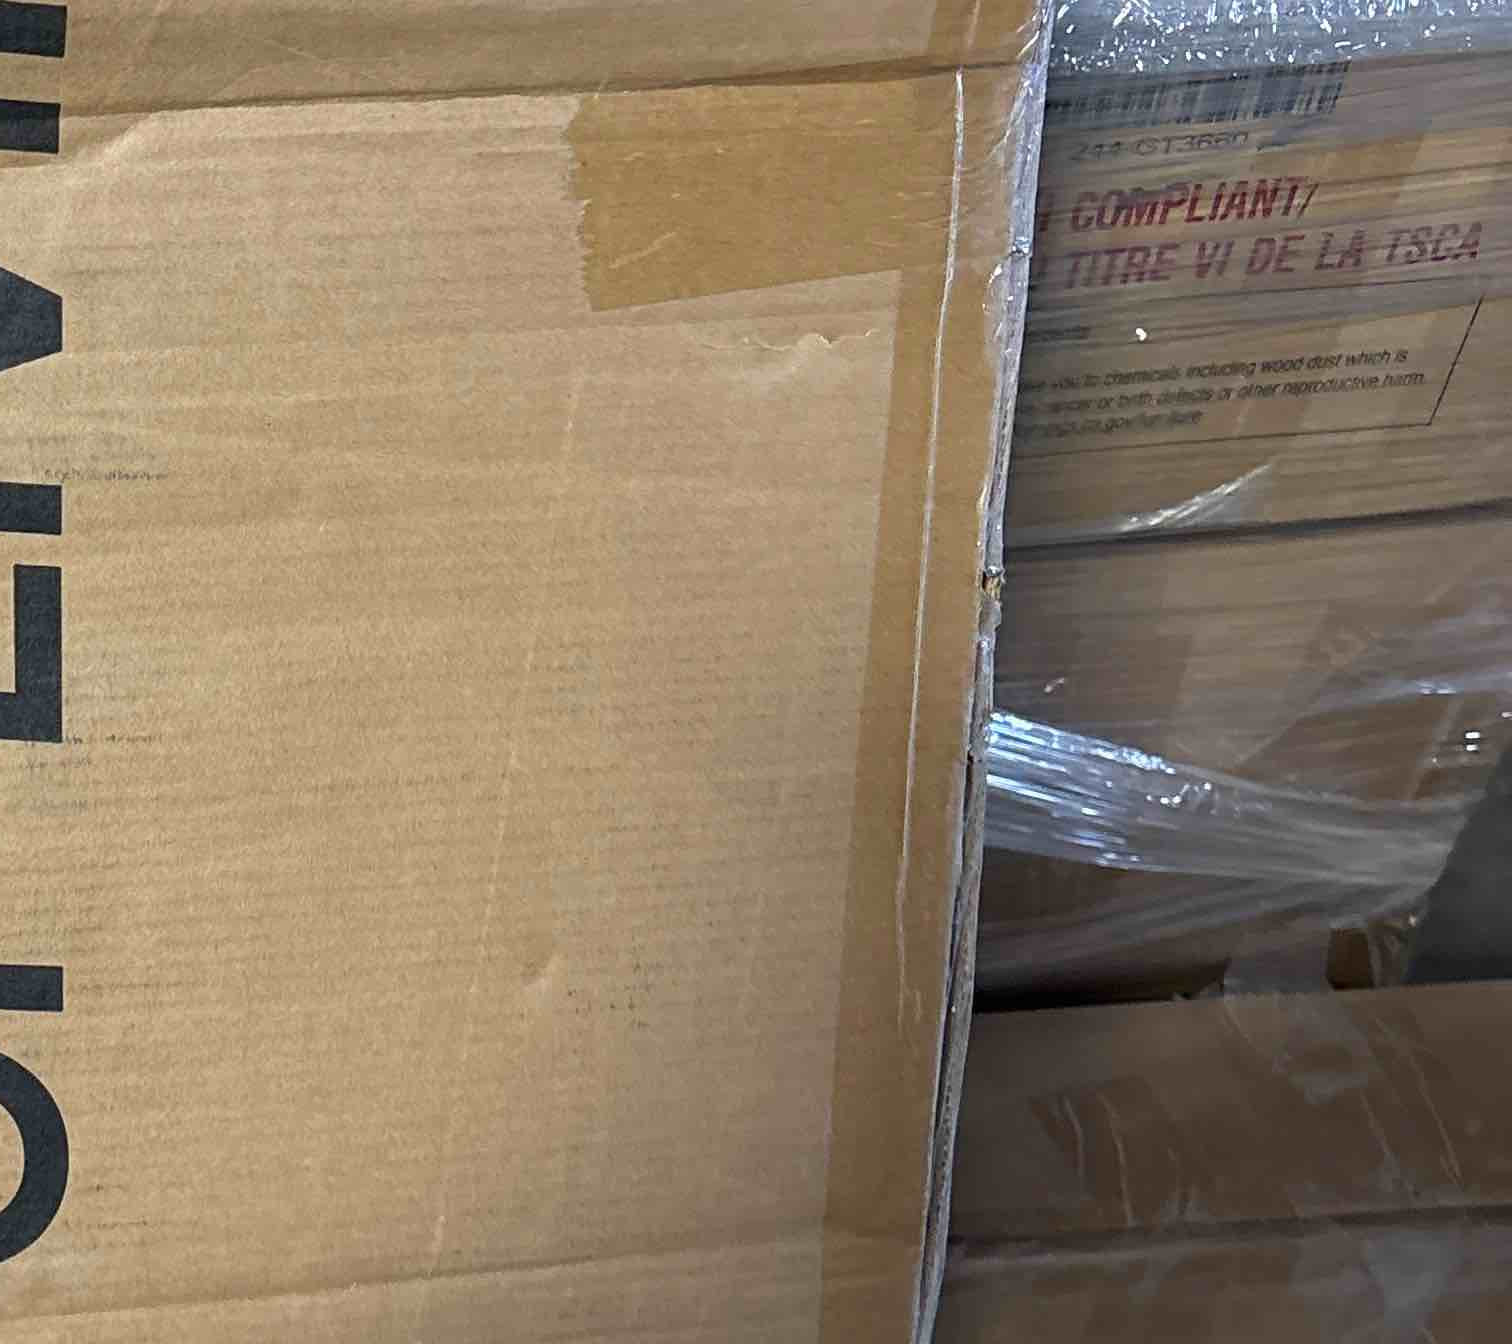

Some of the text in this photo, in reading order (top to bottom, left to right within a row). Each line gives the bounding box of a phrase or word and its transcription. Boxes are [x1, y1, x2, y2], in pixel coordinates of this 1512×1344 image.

[1063, 242, 1180, 290] TITRE
[1193, 239, 1236, 280] VI
[1245, 233, 1306, 276] DE
[1313, 229, 1368, 271] LA
[1385, 221, 1483, 265] TSCA
[1260, 356, 1305, 374] wood
